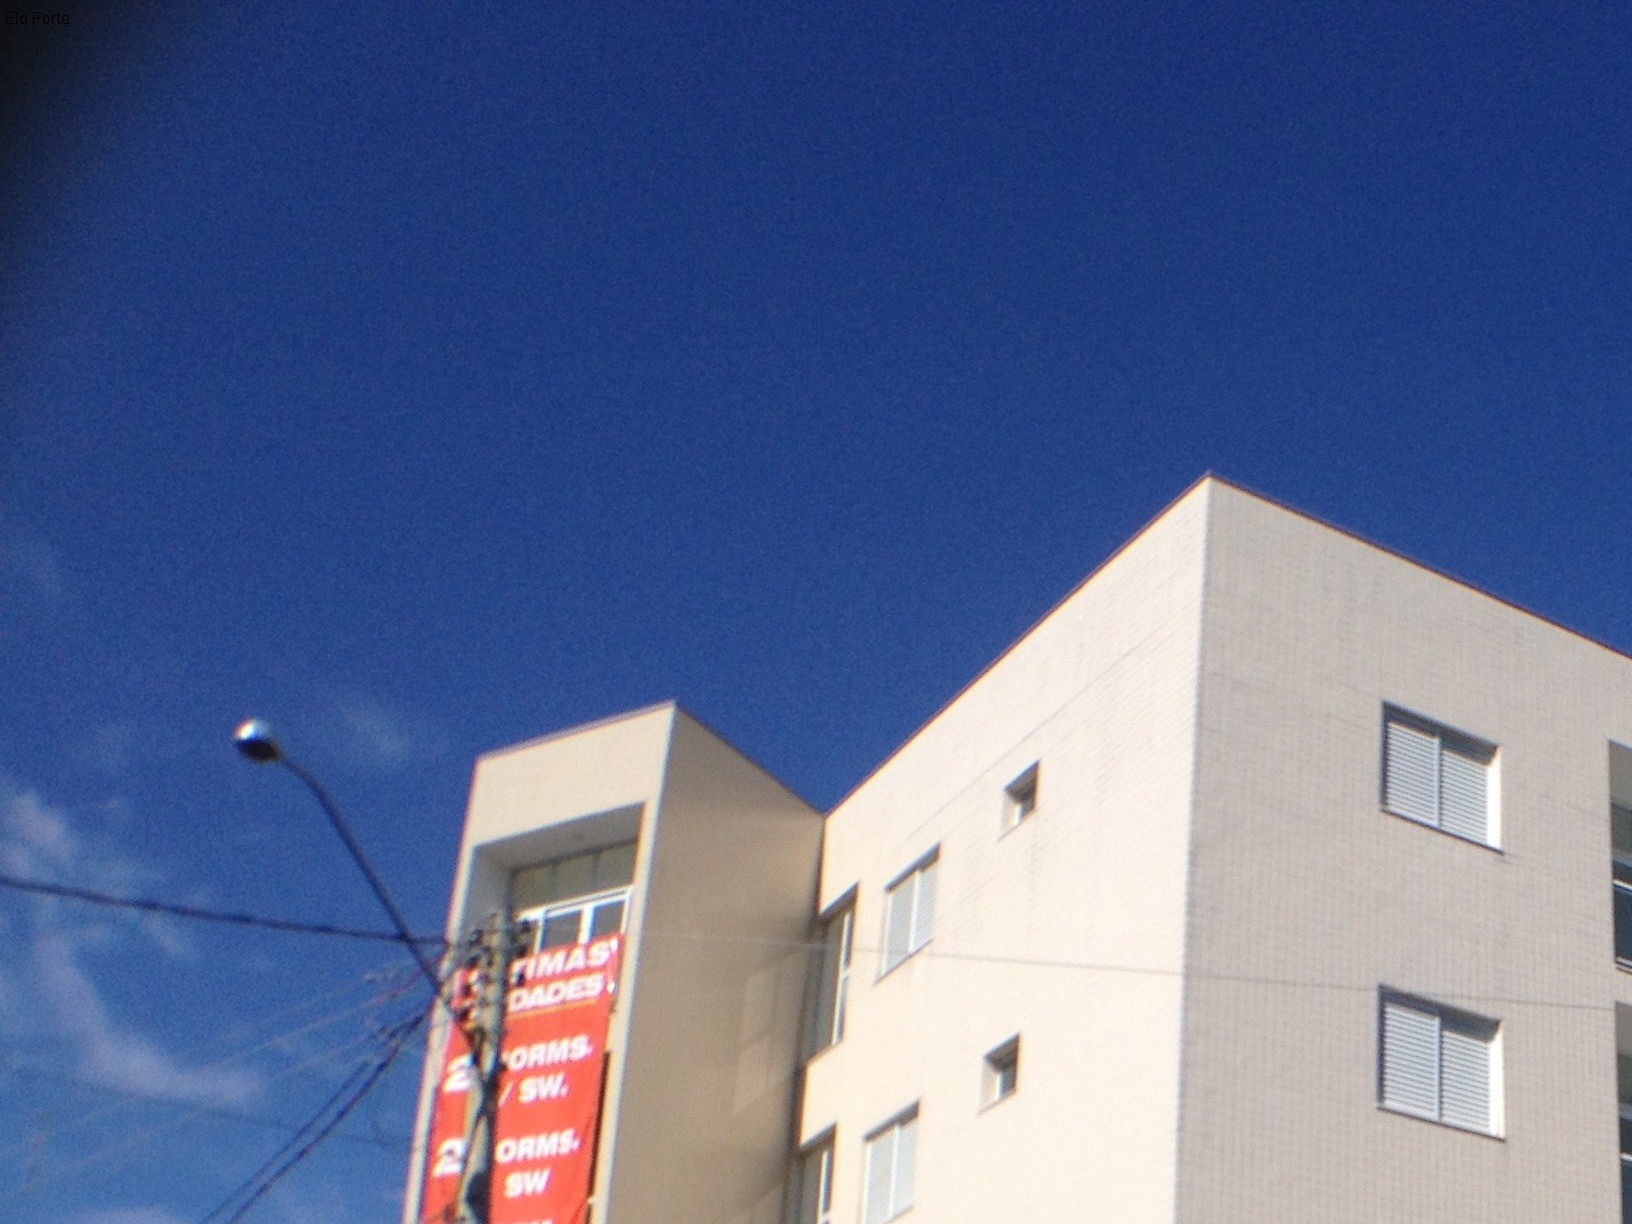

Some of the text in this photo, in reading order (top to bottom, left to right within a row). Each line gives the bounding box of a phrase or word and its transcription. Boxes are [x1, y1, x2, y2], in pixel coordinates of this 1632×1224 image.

[443, 1034, 593, 1093] 2 ORMS.
[431, 1128, 582, 1177] 2 ORMS.
